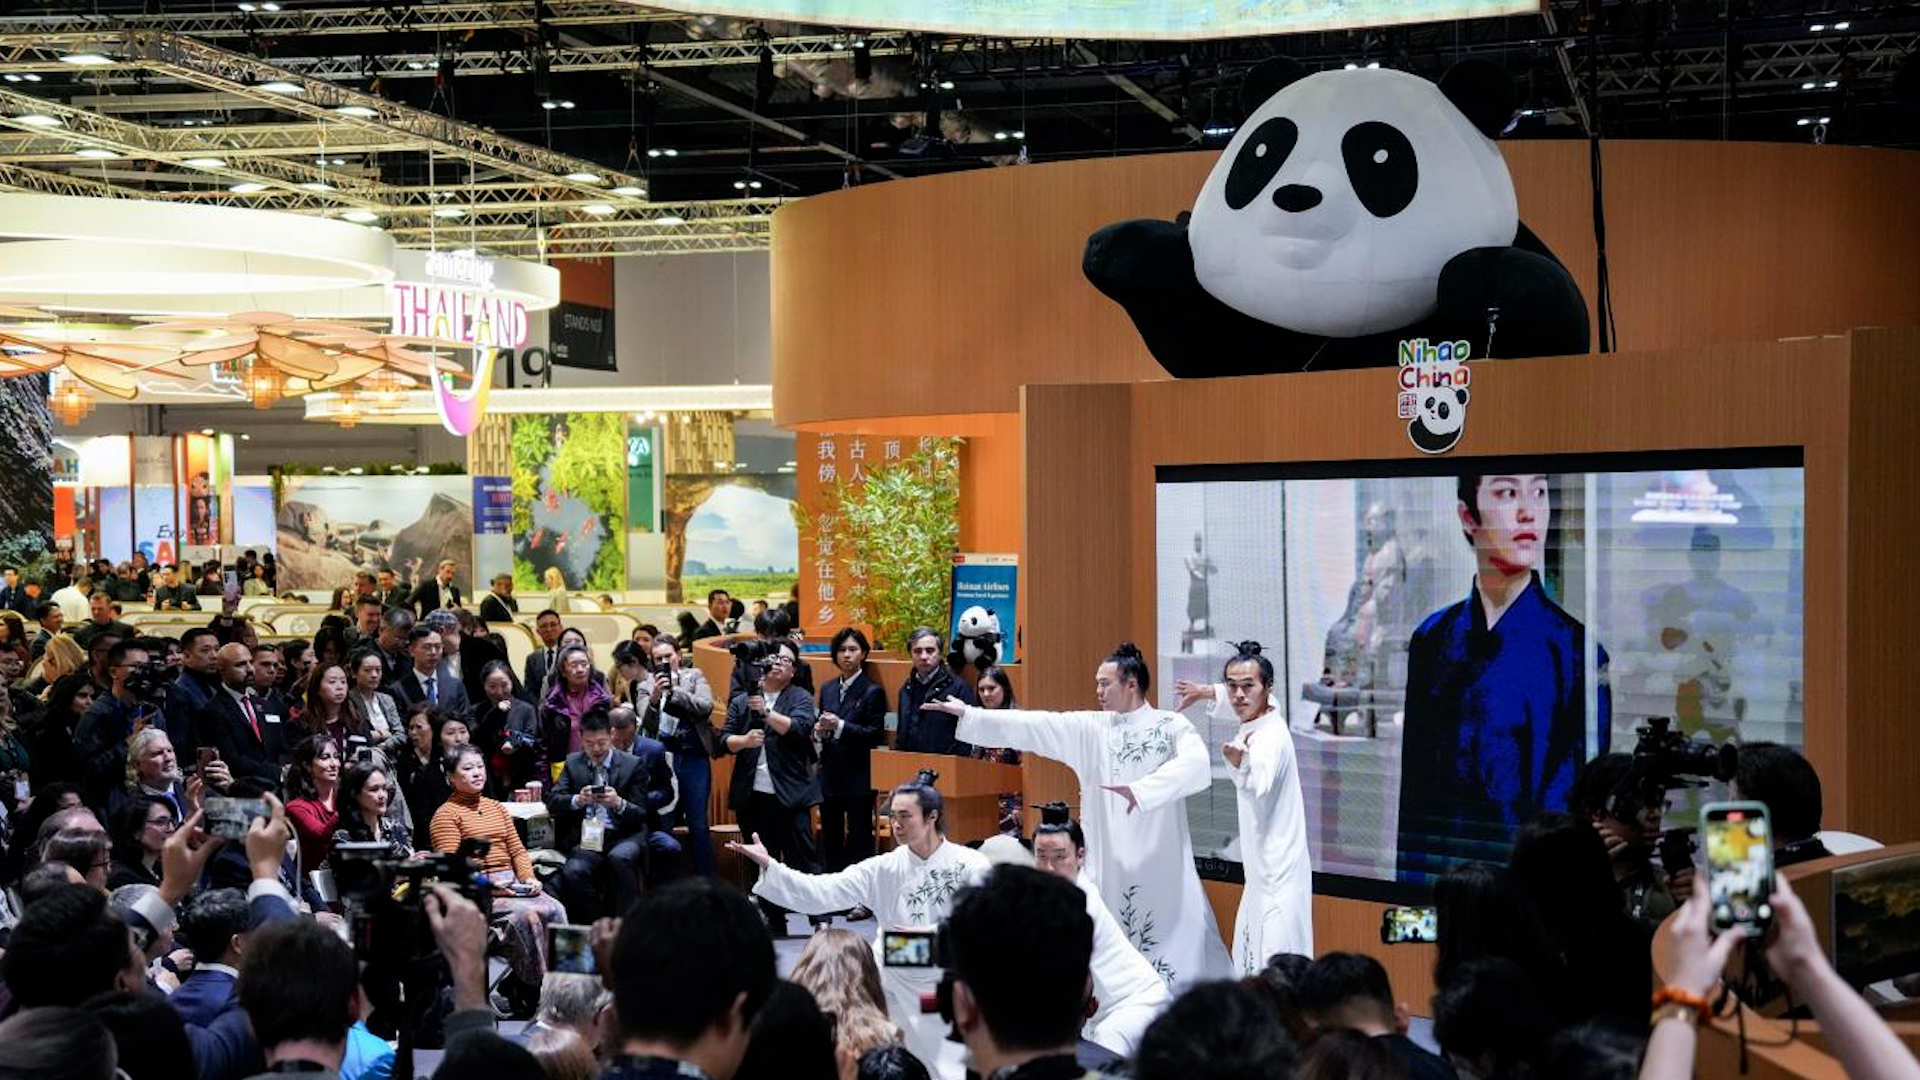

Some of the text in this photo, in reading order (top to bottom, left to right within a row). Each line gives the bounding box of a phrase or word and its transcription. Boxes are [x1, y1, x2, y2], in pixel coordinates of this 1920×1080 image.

[393, 284, 530, 349] THAILAND
[1400, 340, 1469, 362] Nihao
[1400, 366, 1468, 387] China
[50, 458, 79, 474] AH
[818, 432, 836, 483] 我傍
